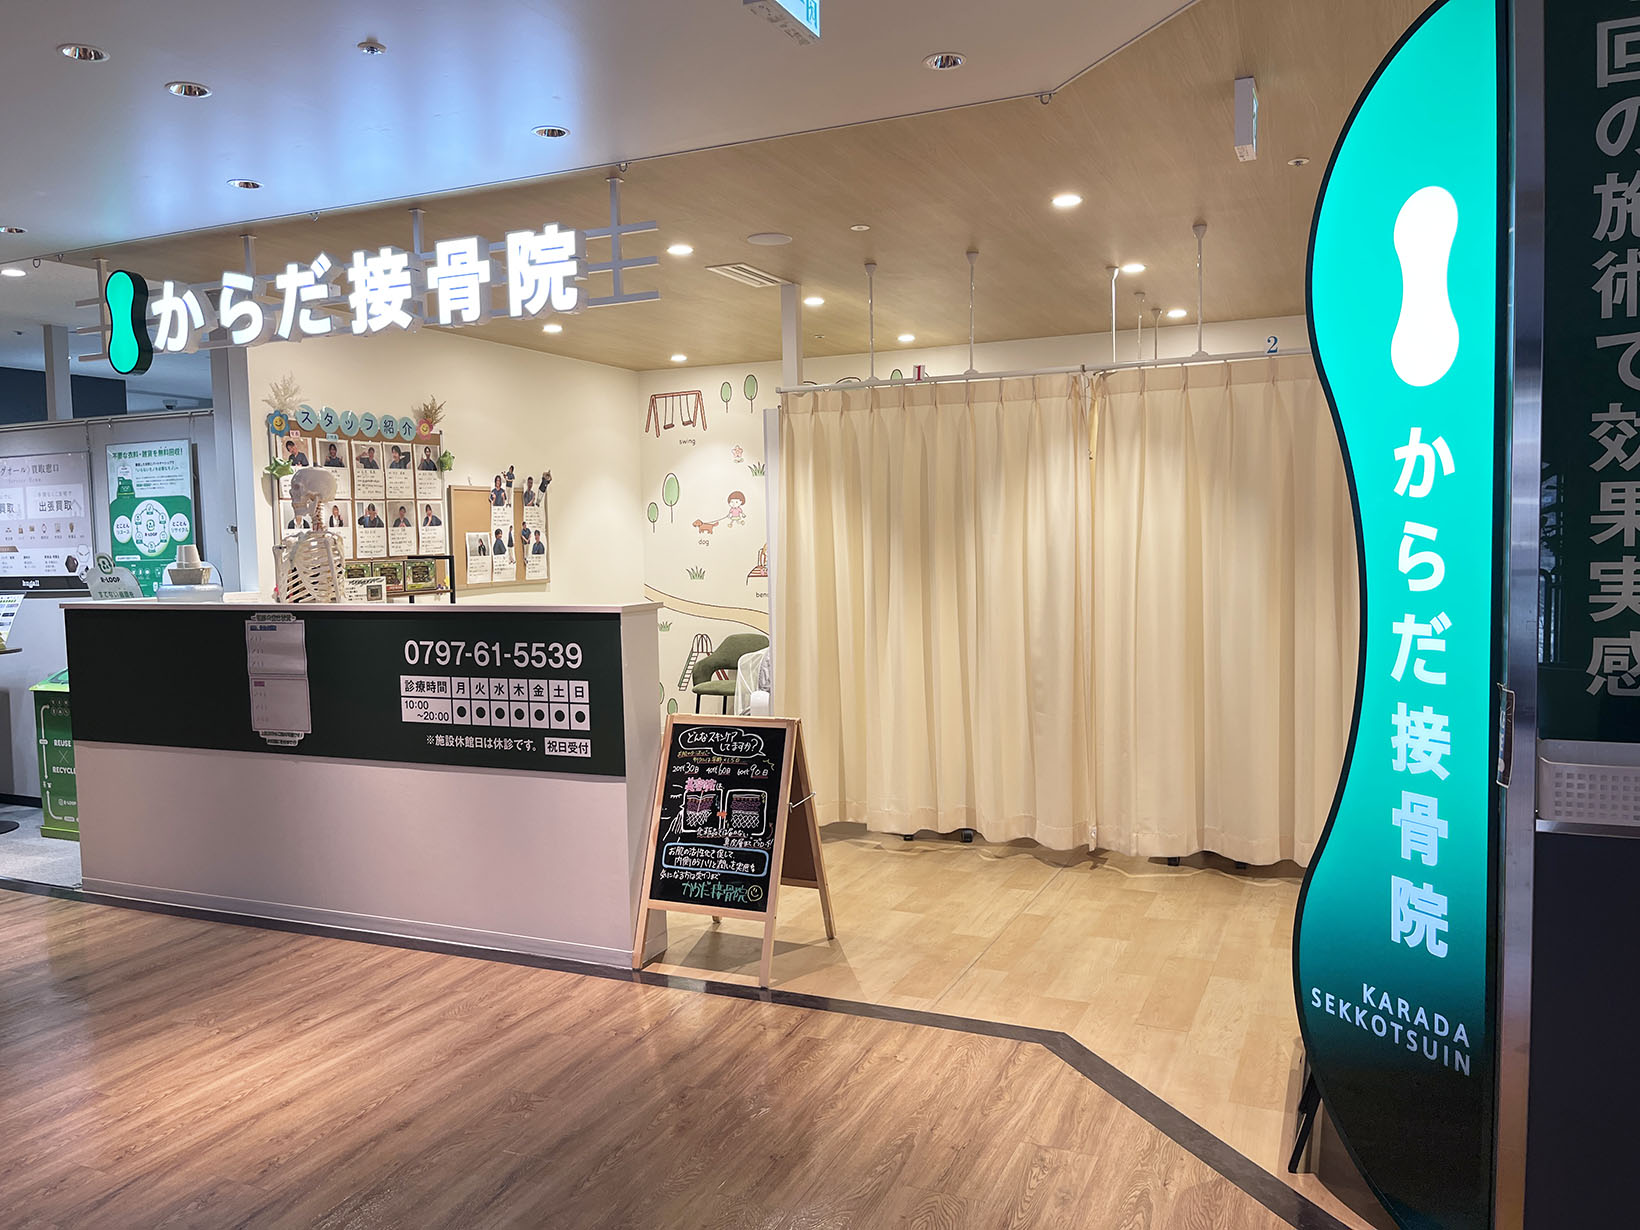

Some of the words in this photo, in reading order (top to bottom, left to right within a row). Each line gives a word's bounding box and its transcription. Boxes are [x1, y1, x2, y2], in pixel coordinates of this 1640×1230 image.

[151, 224, 579, 352] からだ接骨院
[1266, 336, 1279, 353] 2
[915, 365, 923, 380] 1
[301, 411, 413, 436] スタッフ紹介
[679, 438, 696, 446] swing
[39, 500, 73, 512] 出張買取
[698, 538, 710, 547] dog
[404, 639, 583, 669] 0797-61-5539
[404, 680, 448, 694] 診療時間
[455, 681, 466, 695] 月
[474, 682, 486, 695] 火
[493, 683, 505, 696] 水
[513, 684, 525, 697] 木
[532, 684, 544, 698] 金
[553, 685, 565, 698] 土
[574, 686, 584, 699] 日
[1390, 425, 1454, 958] からだ接骨院
[404, 700, 429, 710] 10:00
[53, 739, 72, 748] REUSE
[426, 734, 537, 752] ※施設休館日は休診です。
[687, 731, 739, 744] どんなスキンケア
[547, 740, 589, 755] 祝日受付
[1361, 982, 1471, 1048] KARADA
[1311, 987, 1471, 1077] SEKKOTSUIN
